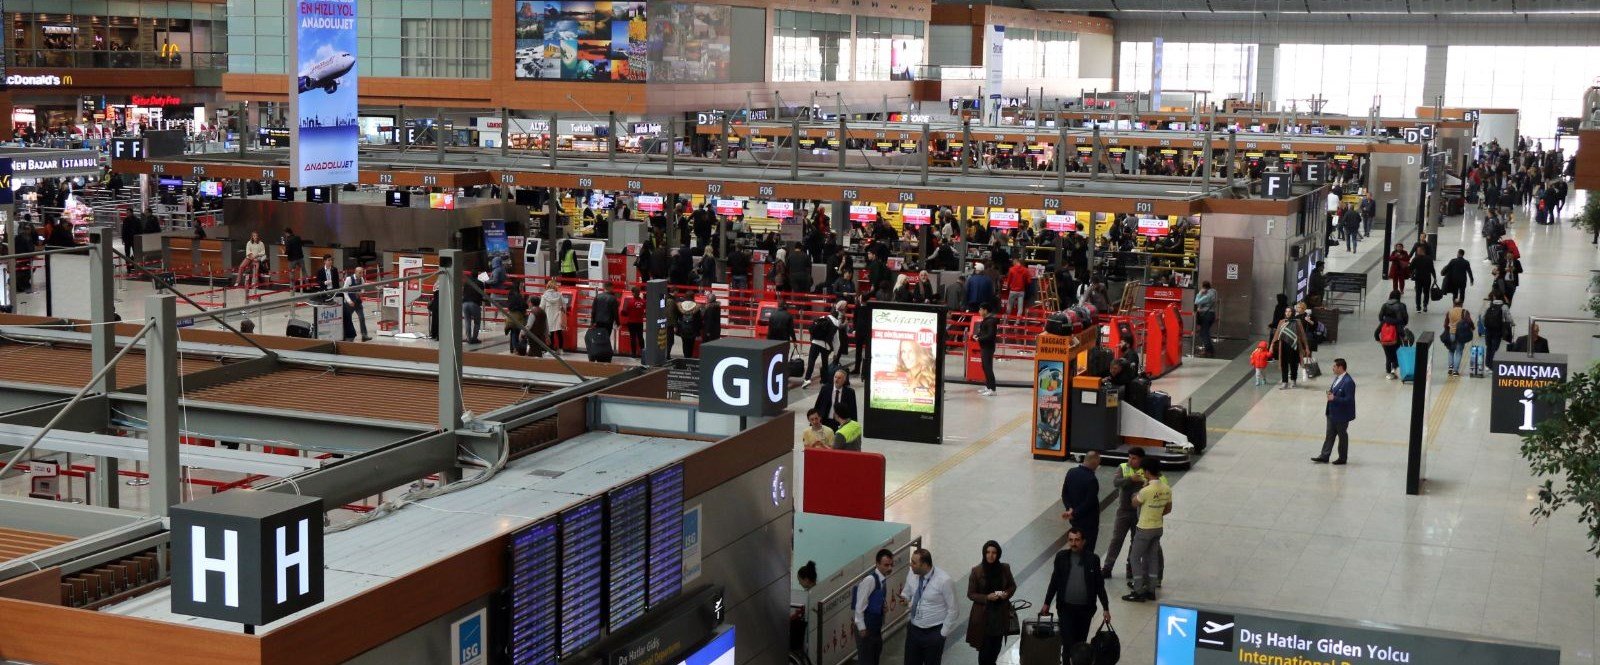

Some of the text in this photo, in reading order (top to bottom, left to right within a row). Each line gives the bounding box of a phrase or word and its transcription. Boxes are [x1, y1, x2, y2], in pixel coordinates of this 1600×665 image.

[301, 2, 353, 16] EN HIZLI YOL
[302, 17, 353, 29] ANADOLUJET
[6, 75, 60, 85] cDonald's
[151, 96, 166, 106] Duty
[166, 96, 181, 105] Free
[699, 114, 707, 124] D
[1465, 113, 1471, 121] B
[571, 124, 591, 132] Turkish
[1421, 127, 1429, 137] C
[409, 129, 414, 142] E
[1408, 131, 1417, 143] D
[116, 141, 124, 157] F
[133, 141, 140, 157] F
[28, 160, 57, 169] BAZAAR
[304, 160, 353, 171] ANADOLUJET
[1407, 156, 1415, 165] D
[194, 166, 205, 175] F15
[263, 170, 274, 178] F14
[1307, 165, 1318, 181] E
[380, 175, 392, 183] F12
[424, 176, 435, 184] F11
[502, 175, 513, 183] F10
[628, 181, 640, 189] F08
[1269, 176, 1280, 196] F
[760, 187, 772, 195] F06
[844, 191, 856, 199] F05
[900, 193, 913, 201] F04
[989, 197, 1003, 205] F03
[1044, 200, 1059, 208] F02
[1137, 203, 1151, 211] F01
[1041, 337, 1066, 345] BAGGAGE
[1499, 364, 1561, 379] DANIŞMA
[712, 357, 750, 406] G
[767, 354, 783, 403] G
[191, 518, 309, 608] H H
[1240, 629, 1409, 662] Dış Hatlar Giden Yolcu
[463, 643, 478, 662] ISG
